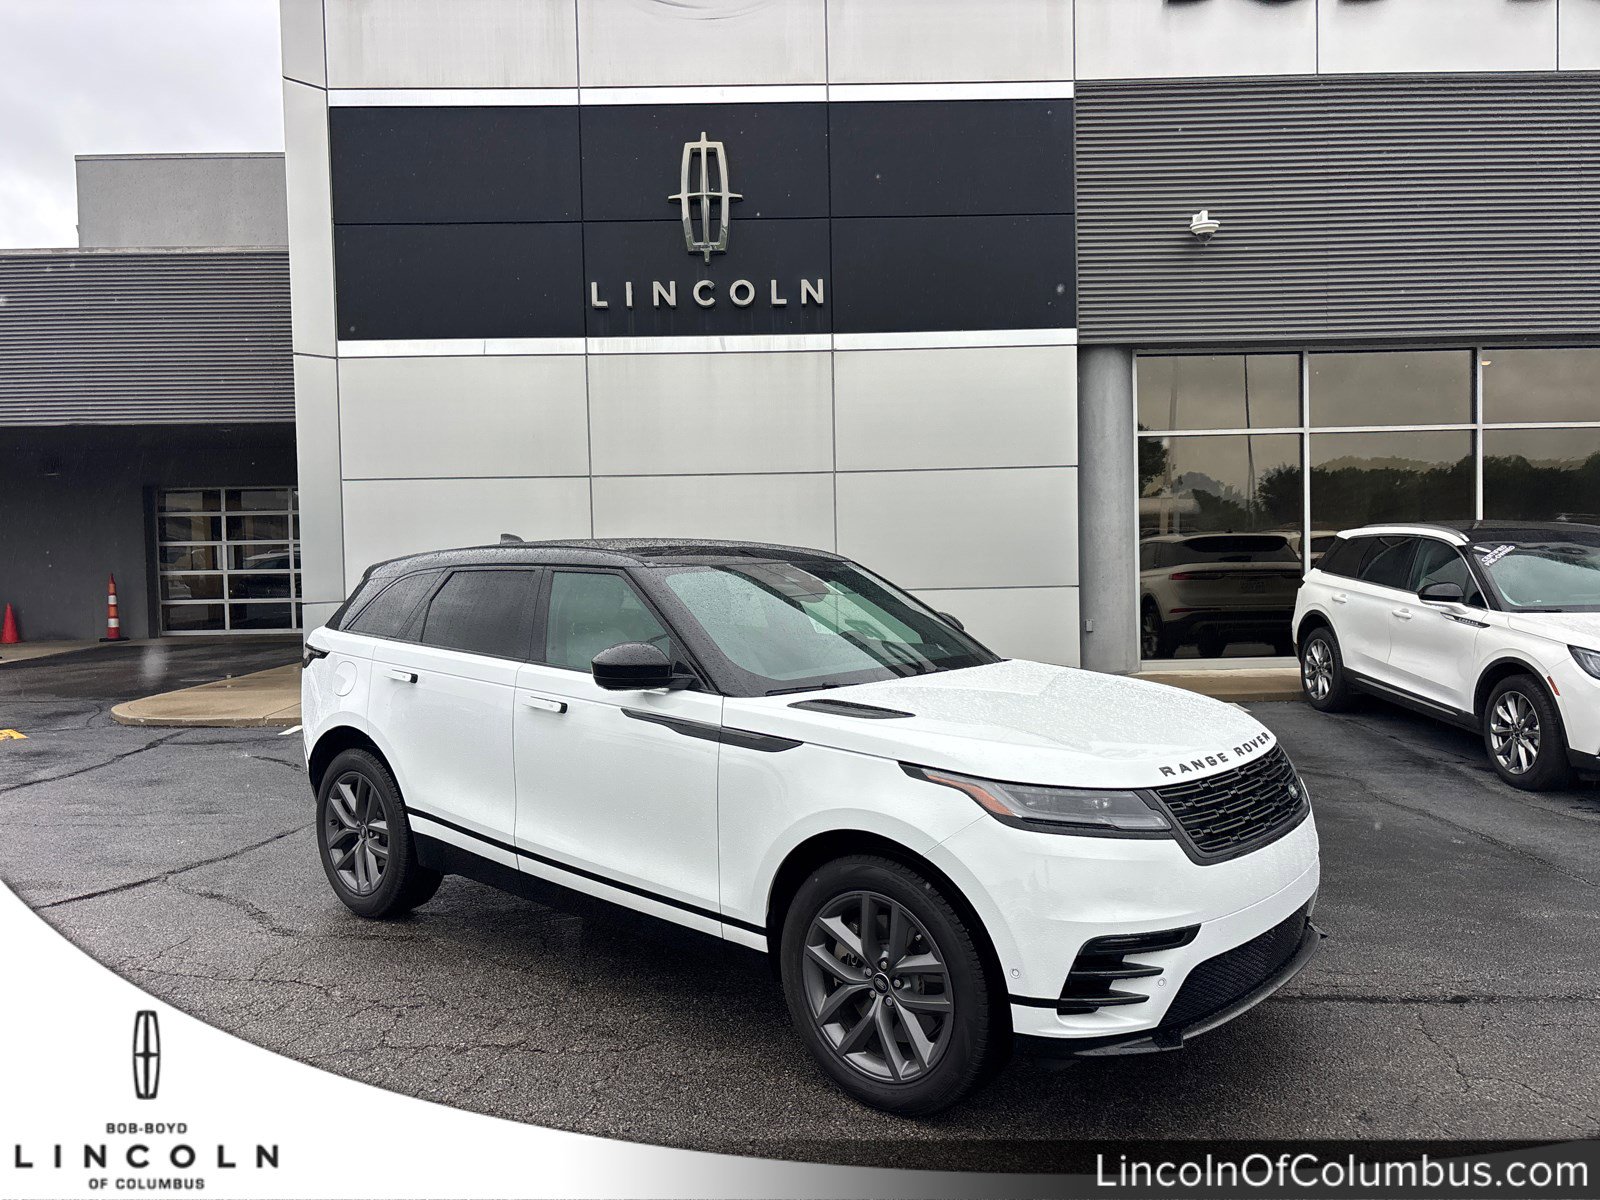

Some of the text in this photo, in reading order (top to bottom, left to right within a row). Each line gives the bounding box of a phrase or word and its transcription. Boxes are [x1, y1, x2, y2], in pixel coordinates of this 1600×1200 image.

[591, 278, 824, 309] LINCOLN
[1158, 731, 1271, 777] RANGE ROVER
